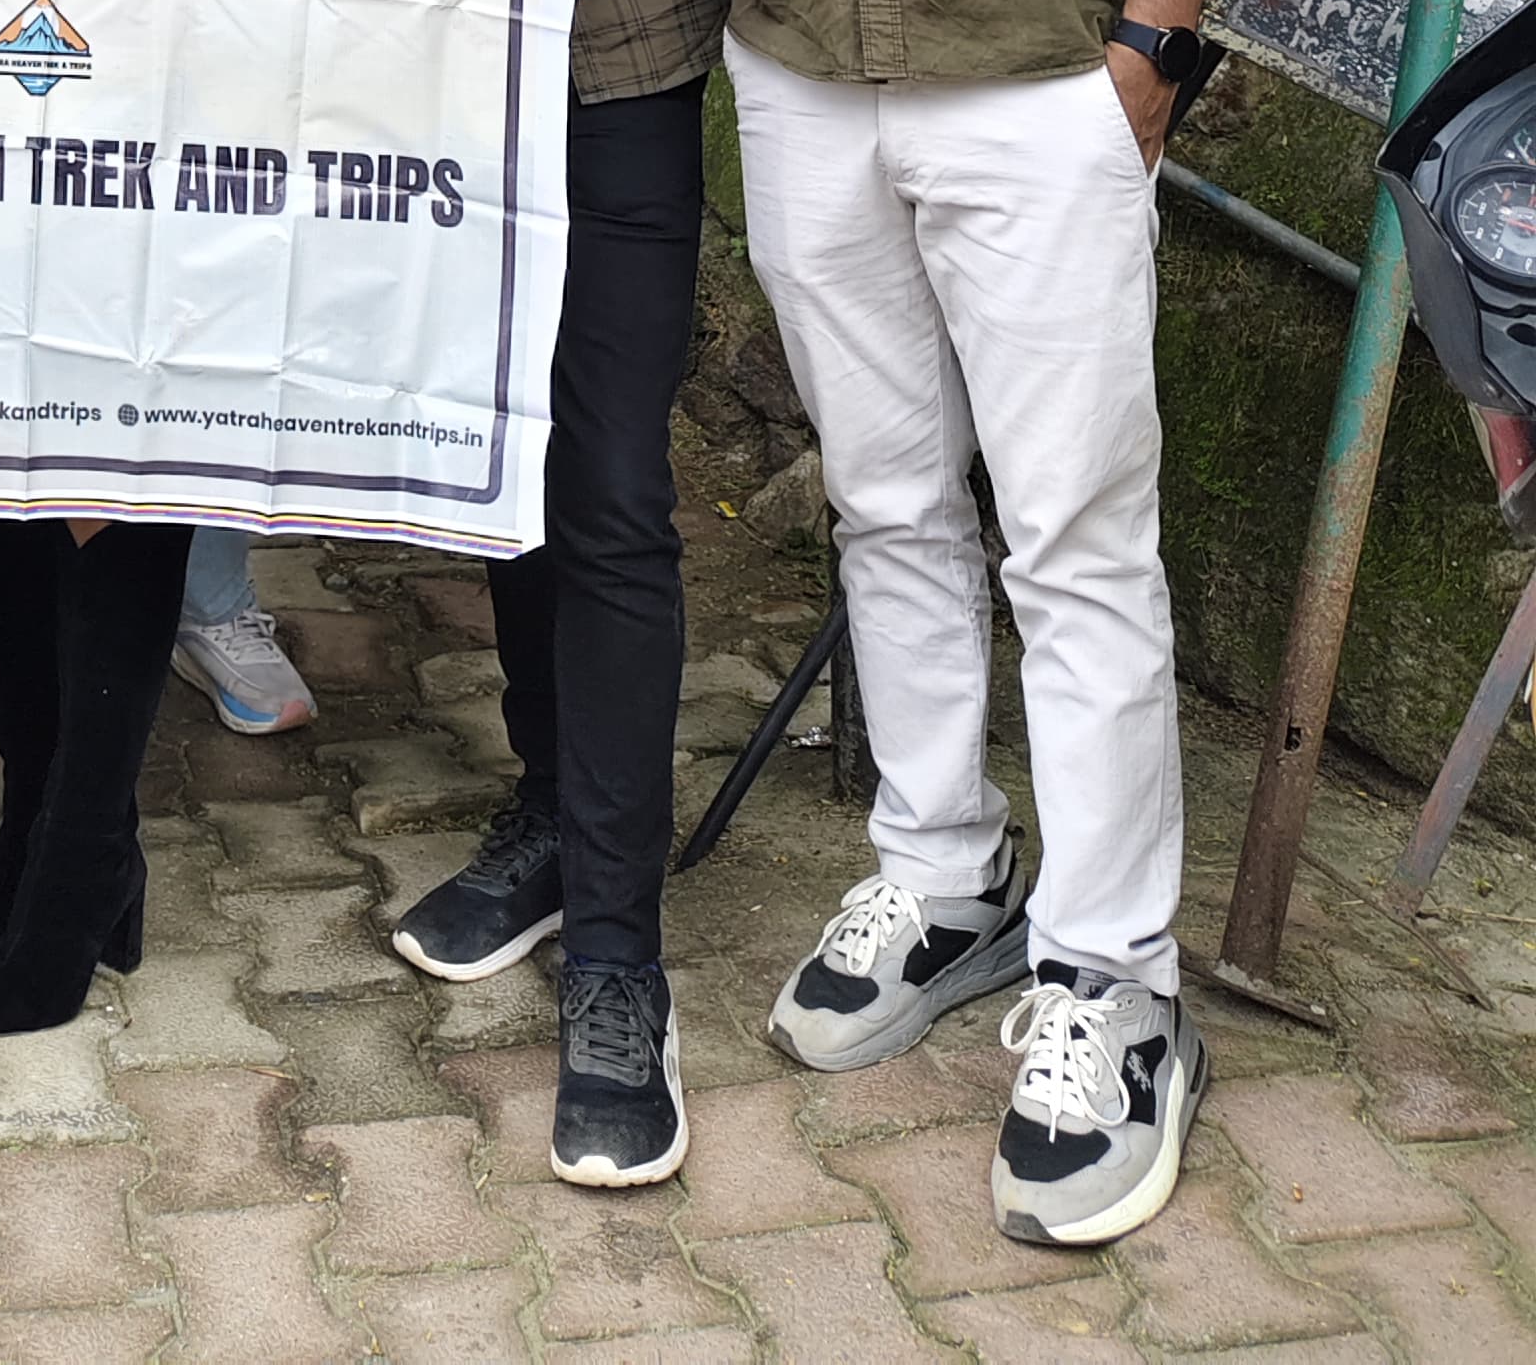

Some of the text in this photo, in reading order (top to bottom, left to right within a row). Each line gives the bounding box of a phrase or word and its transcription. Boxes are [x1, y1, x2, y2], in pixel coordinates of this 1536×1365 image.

[25, 136, 157, 210] TREK
[174, 143, 288, 216] AND
[307, 150, 464, 228] TRIPS
[144, 407, 483, 448] www.yatraheaventrekandtrips.in
